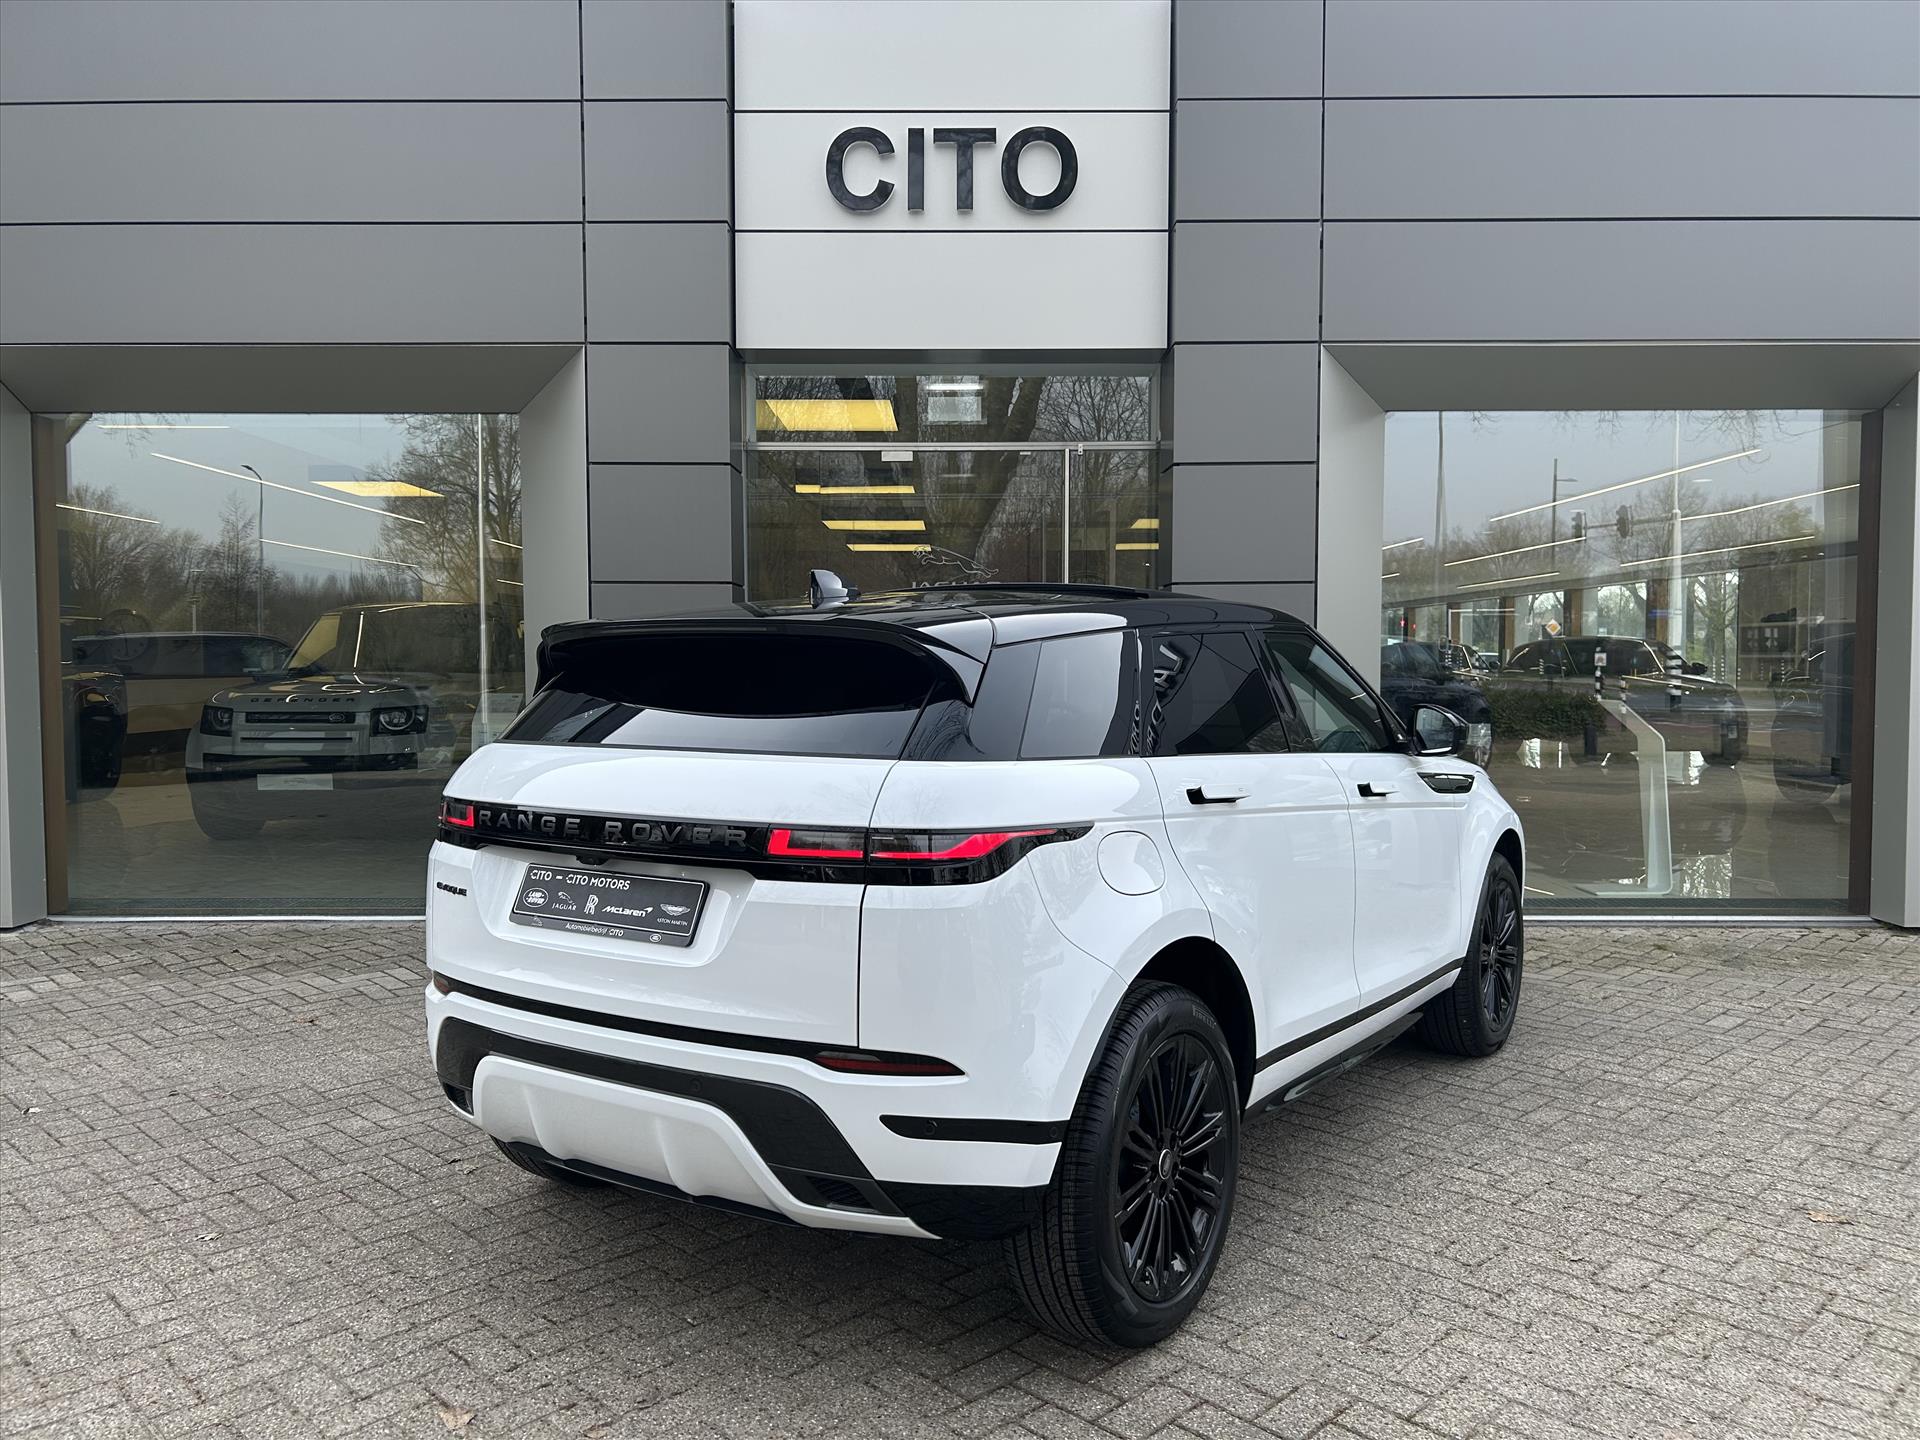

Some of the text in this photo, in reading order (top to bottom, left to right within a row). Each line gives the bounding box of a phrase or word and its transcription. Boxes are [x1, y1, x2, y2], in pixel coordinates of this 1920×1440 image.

[826, 126, 1079, 213] CITO
[478, 809, 747, 848] RANGE ROVER
[530, 869, 553, 881] CITO
[565, 873, 589, 886] CITO
[589, 876, 631, 891] MOTORS
[601, 905, 646, 918] McLaren
[608, 928, 624, 937] CITO
